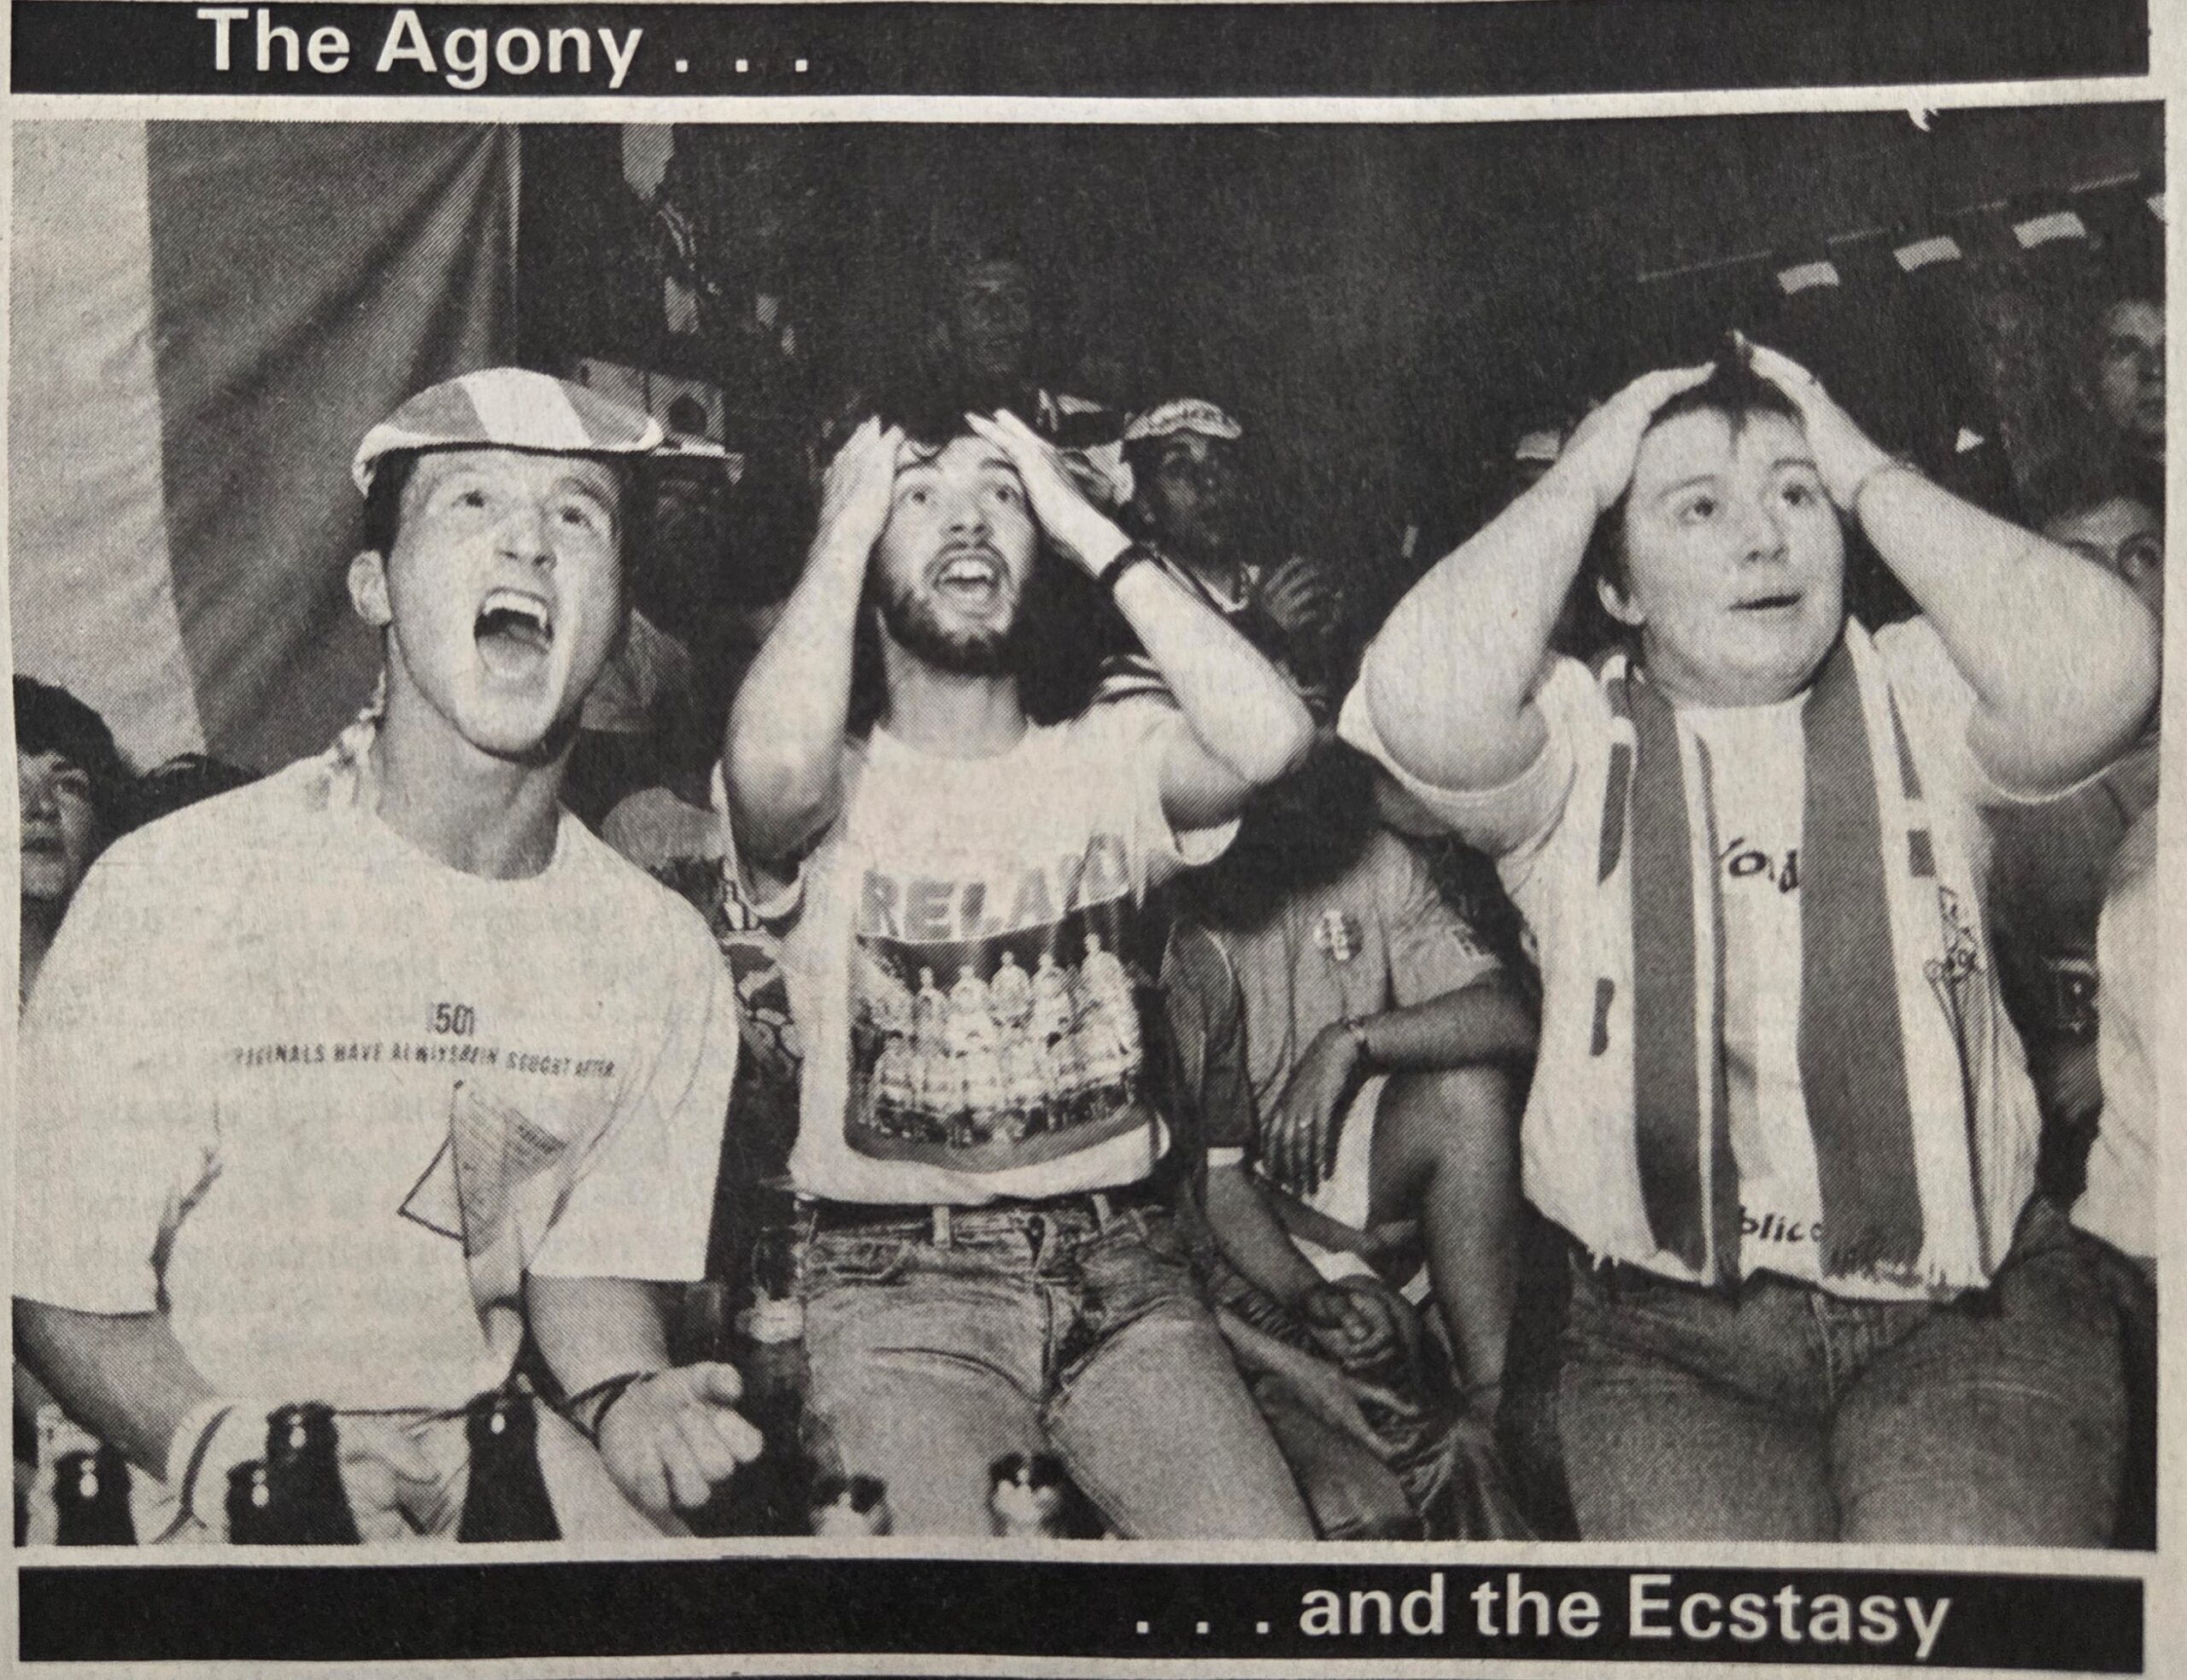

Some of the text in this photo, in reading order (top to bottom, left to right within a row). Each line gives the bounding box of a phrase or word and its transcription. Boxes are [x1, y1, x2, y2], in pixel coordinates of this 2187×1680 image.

[196, 8, 350, 73] The
[375, 9, 643, 90] Agony
[1299, 1572, 1444, 1636] and
[1470, 1572, 1601, 1638] the
[1629, 1574, 1952, 1660] Ecstasy
